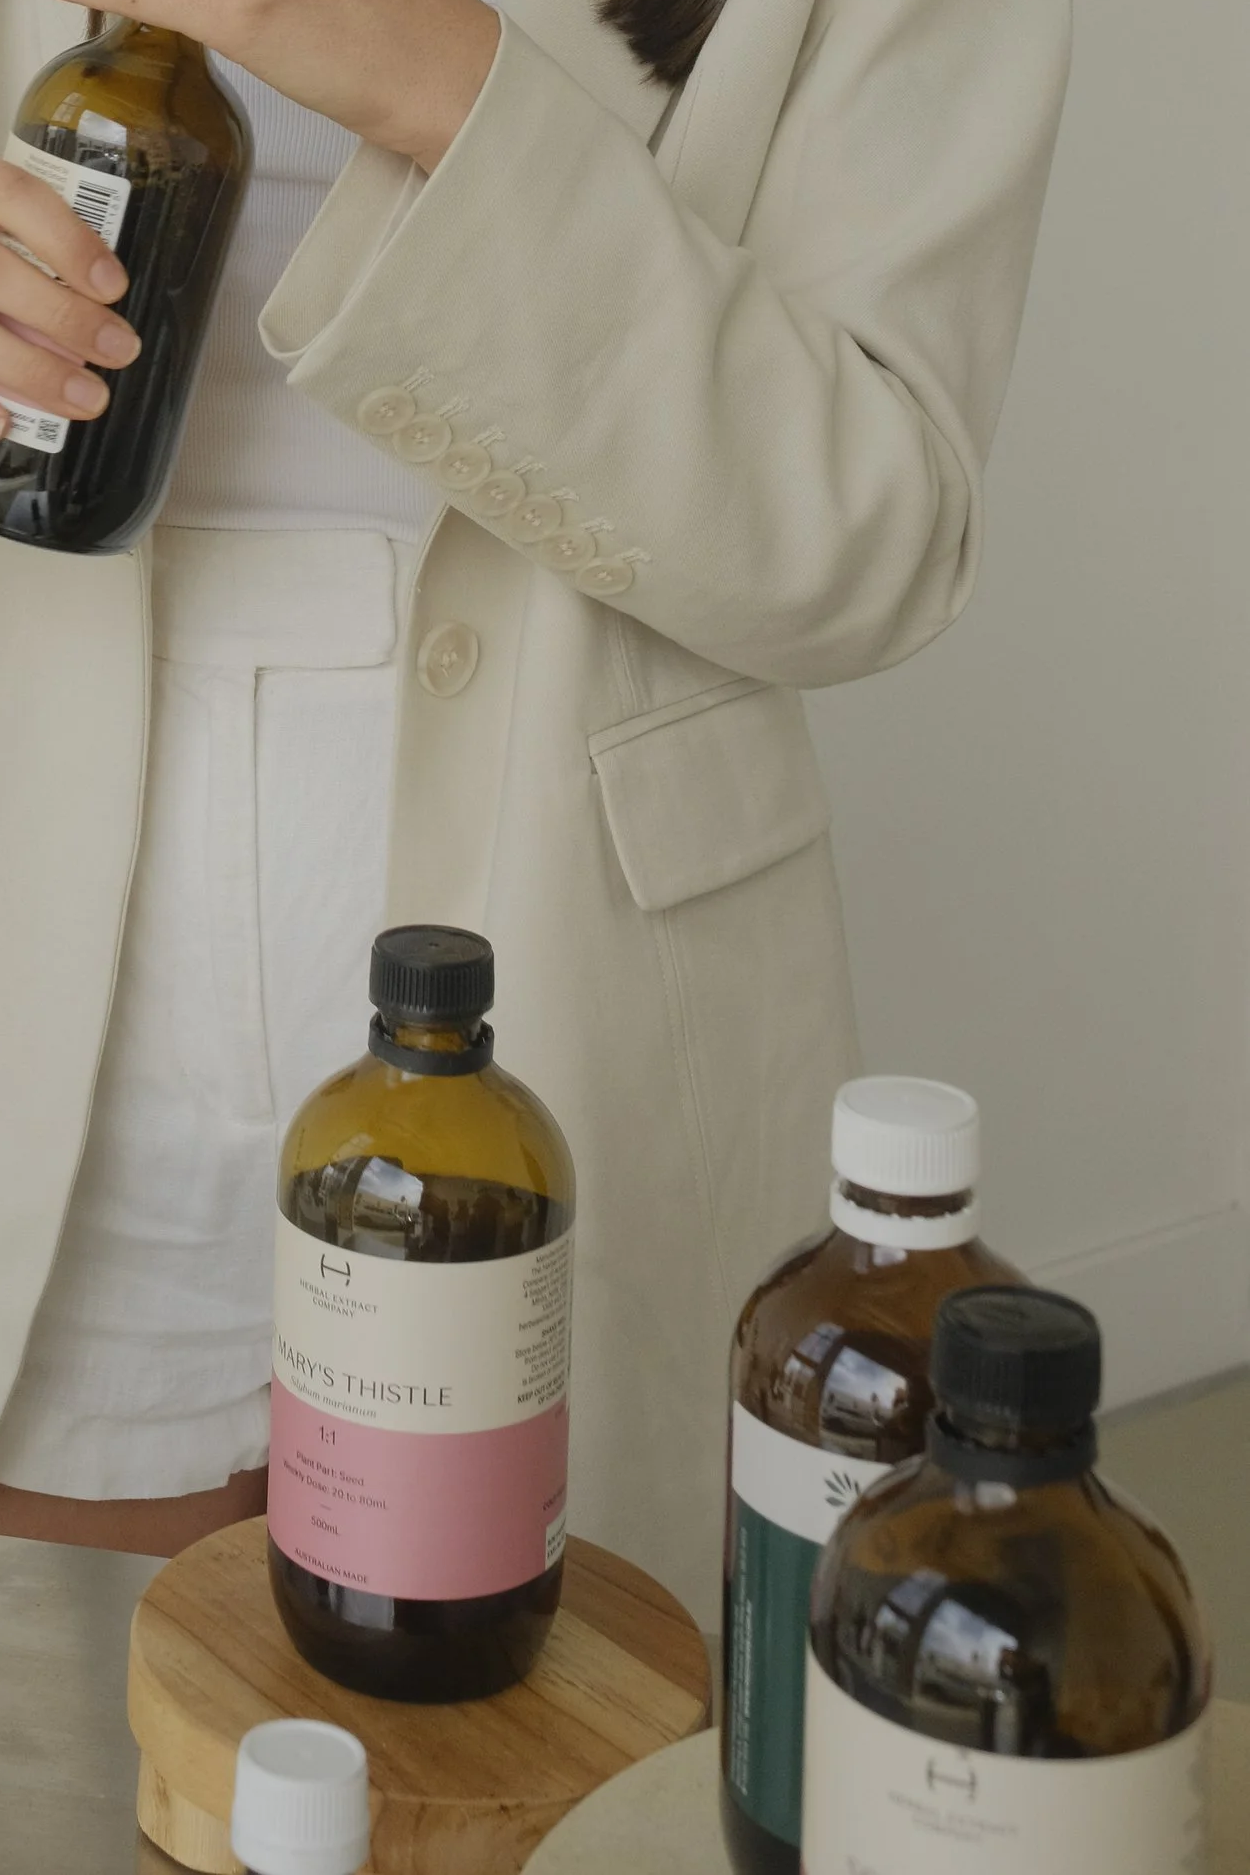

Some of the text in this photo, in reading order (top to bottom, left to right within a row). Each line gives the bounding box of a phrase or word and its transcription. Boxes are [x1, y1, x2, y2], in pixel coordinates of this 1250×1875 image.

[300, 1278, 378, 1314] HERBAL EXTRACT
[312, 1296, 355, 1319] COMPANY
[278, 1334, 453, 1407] MARY'S THISTLE
[318, 1425, 337, 1446] 1:1
[296, 1449, 315, 1468] Plant
[339, 1469, 364, 1487] Seed
[332, 1486, 344, 1500] 20
[346, 1491, 356, 1502] to
[310, 1515, 341, 1536] 500mL
[294, 1547, 368, 1584] AUSTRALIAN MADE
